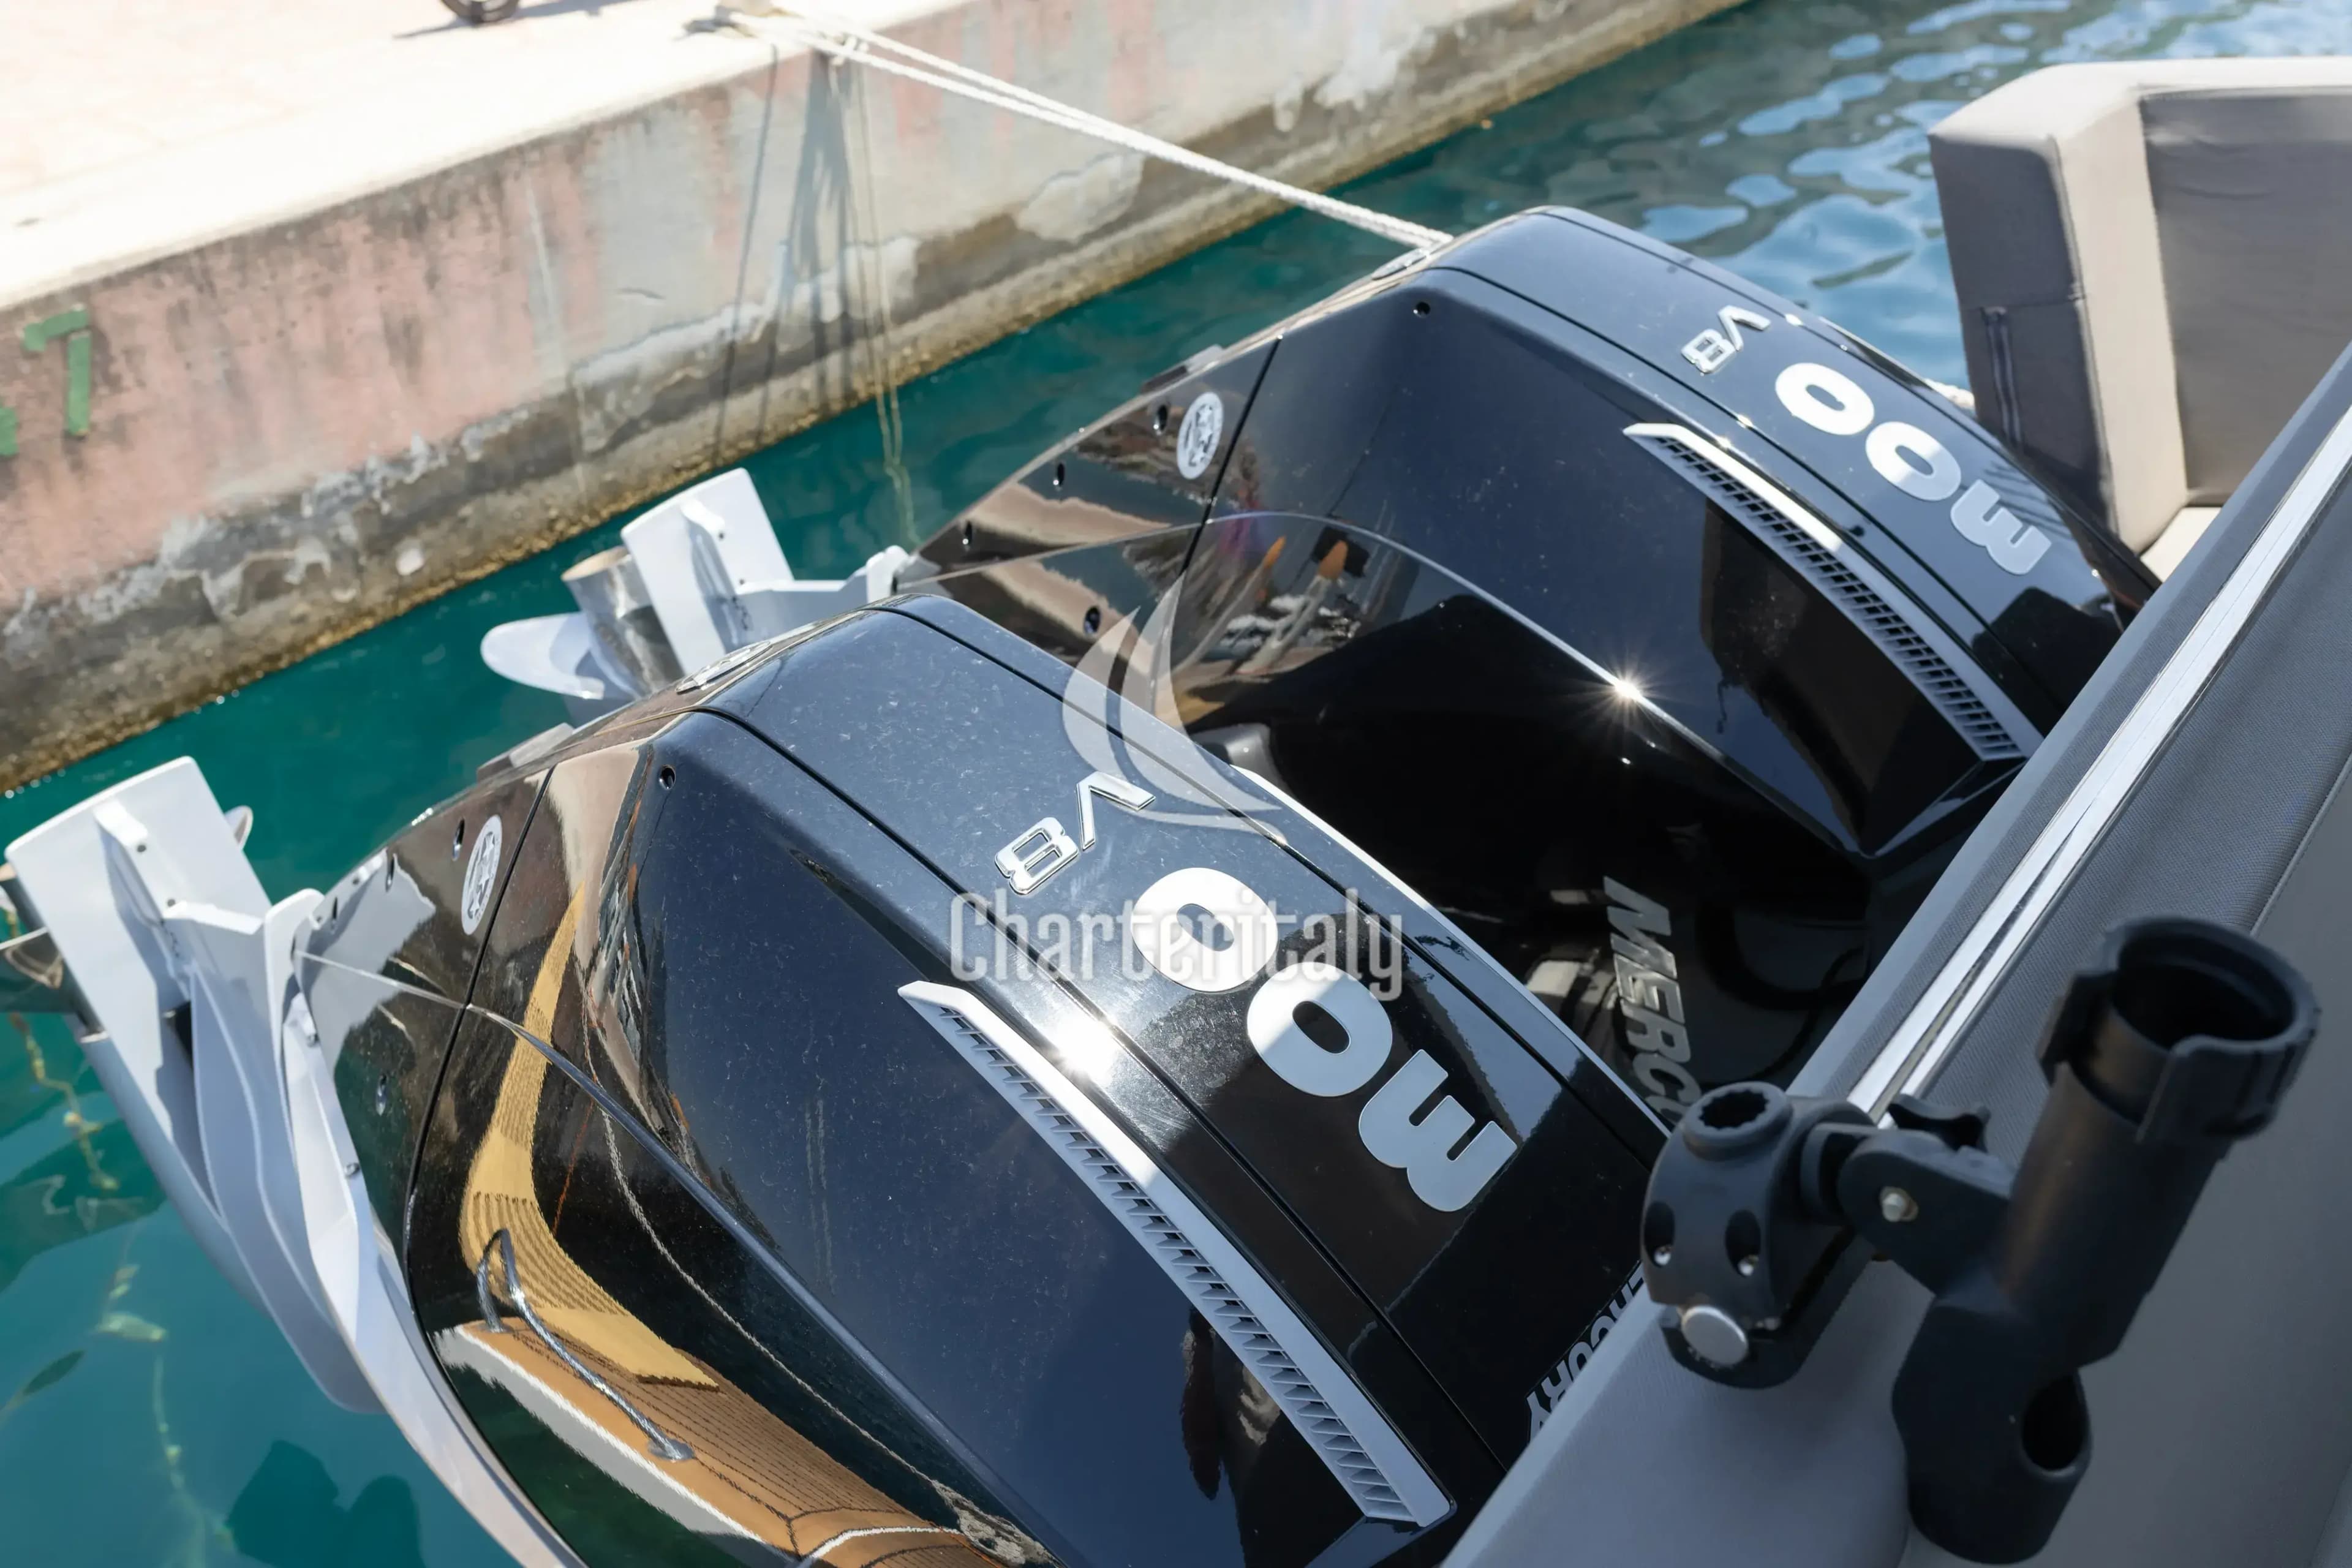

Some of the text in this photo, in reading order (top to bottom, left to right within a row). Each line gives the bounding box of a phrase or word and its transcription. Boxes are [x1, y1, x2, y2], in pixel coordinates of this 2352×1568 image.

[0, 304, 91, 455] 7
[1680, 304, 1771, 375] V8
[1775, 362, 2052, 575] 300
[995, 771, 1156, 895] V8
[1130, 867, 1517, 1212] 300
